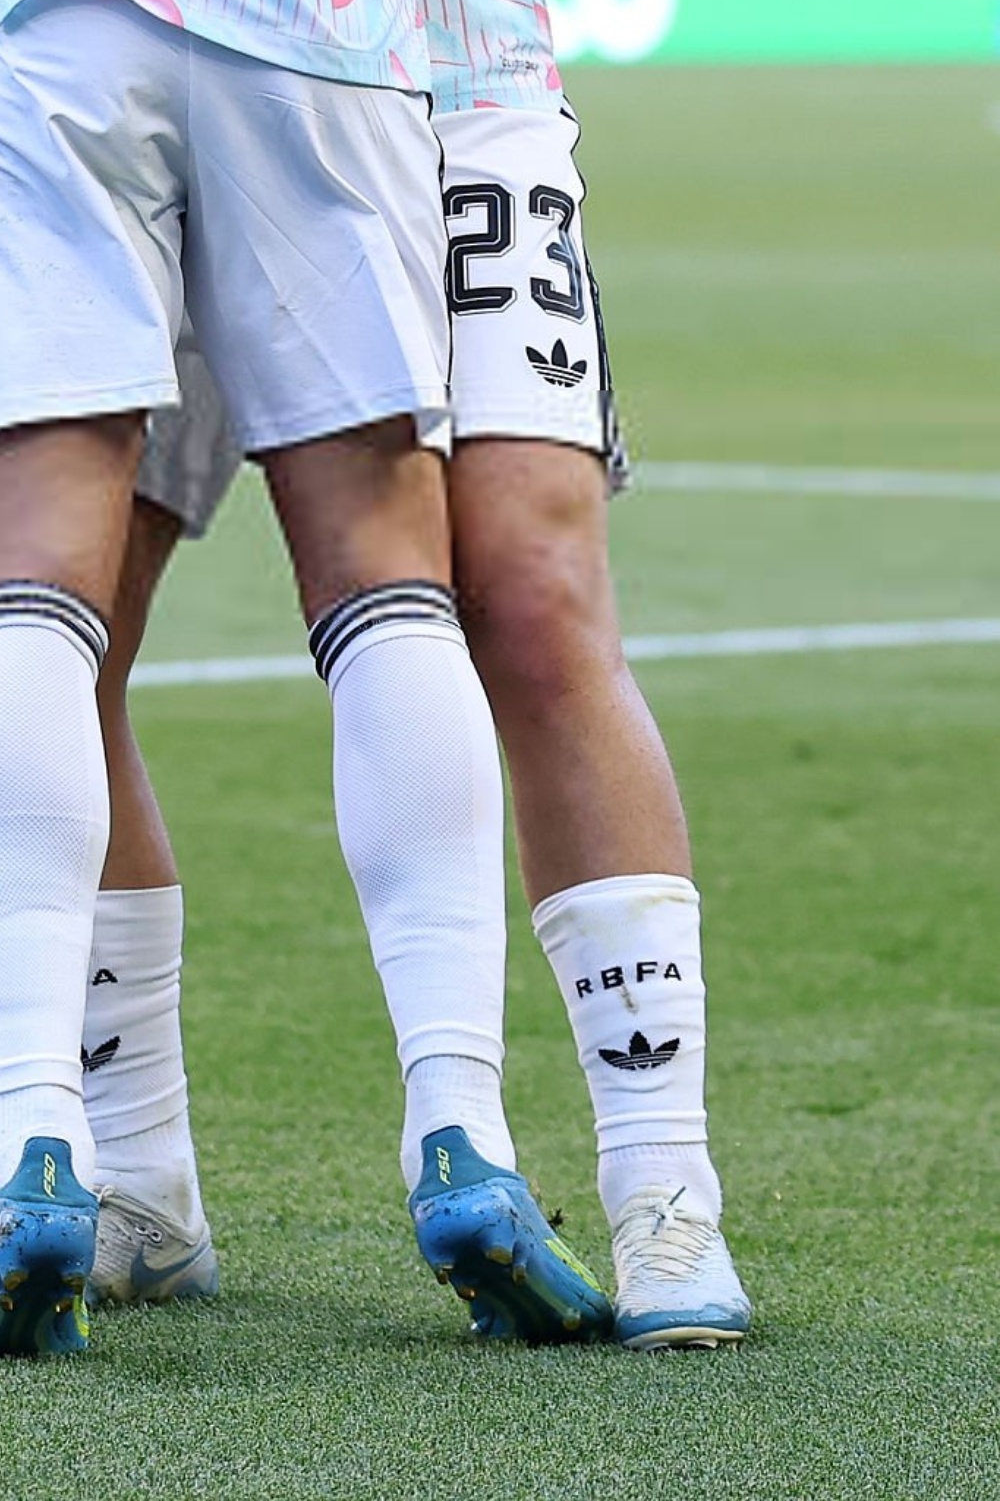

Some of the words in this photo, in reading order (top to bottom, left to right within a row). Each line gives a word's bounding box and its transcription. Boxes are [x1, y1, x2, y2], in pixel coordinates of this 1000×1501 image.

[442, 183, 588, 325] 23
[575, 961, 682, 999] RBFA
[43, 1152, 56, 1199] F50
[436, 1146, 452, 1186] F50
